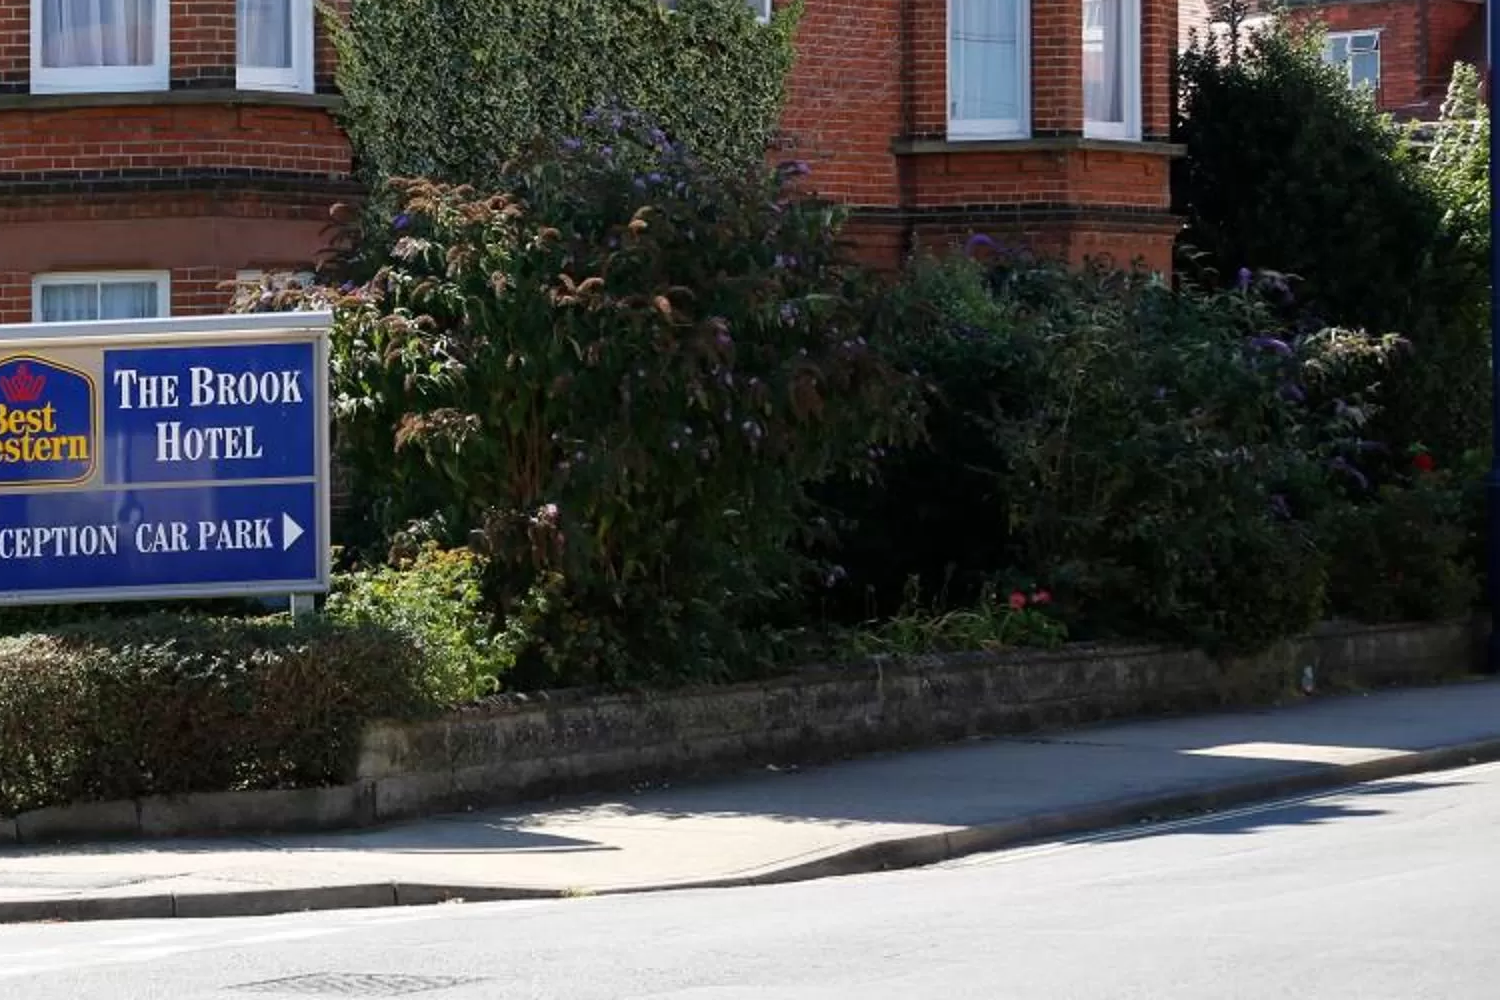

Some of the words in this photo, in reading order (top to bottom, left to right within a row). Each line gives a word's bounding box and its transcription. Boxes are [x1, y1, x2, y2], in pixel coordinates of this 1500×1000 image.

[189, 366, 303, 407] BROOK
[156, 421, 263, 461] HOTEL
[135, 521, 190, 553] CAR
[199, 518, 273, 551] PARK
